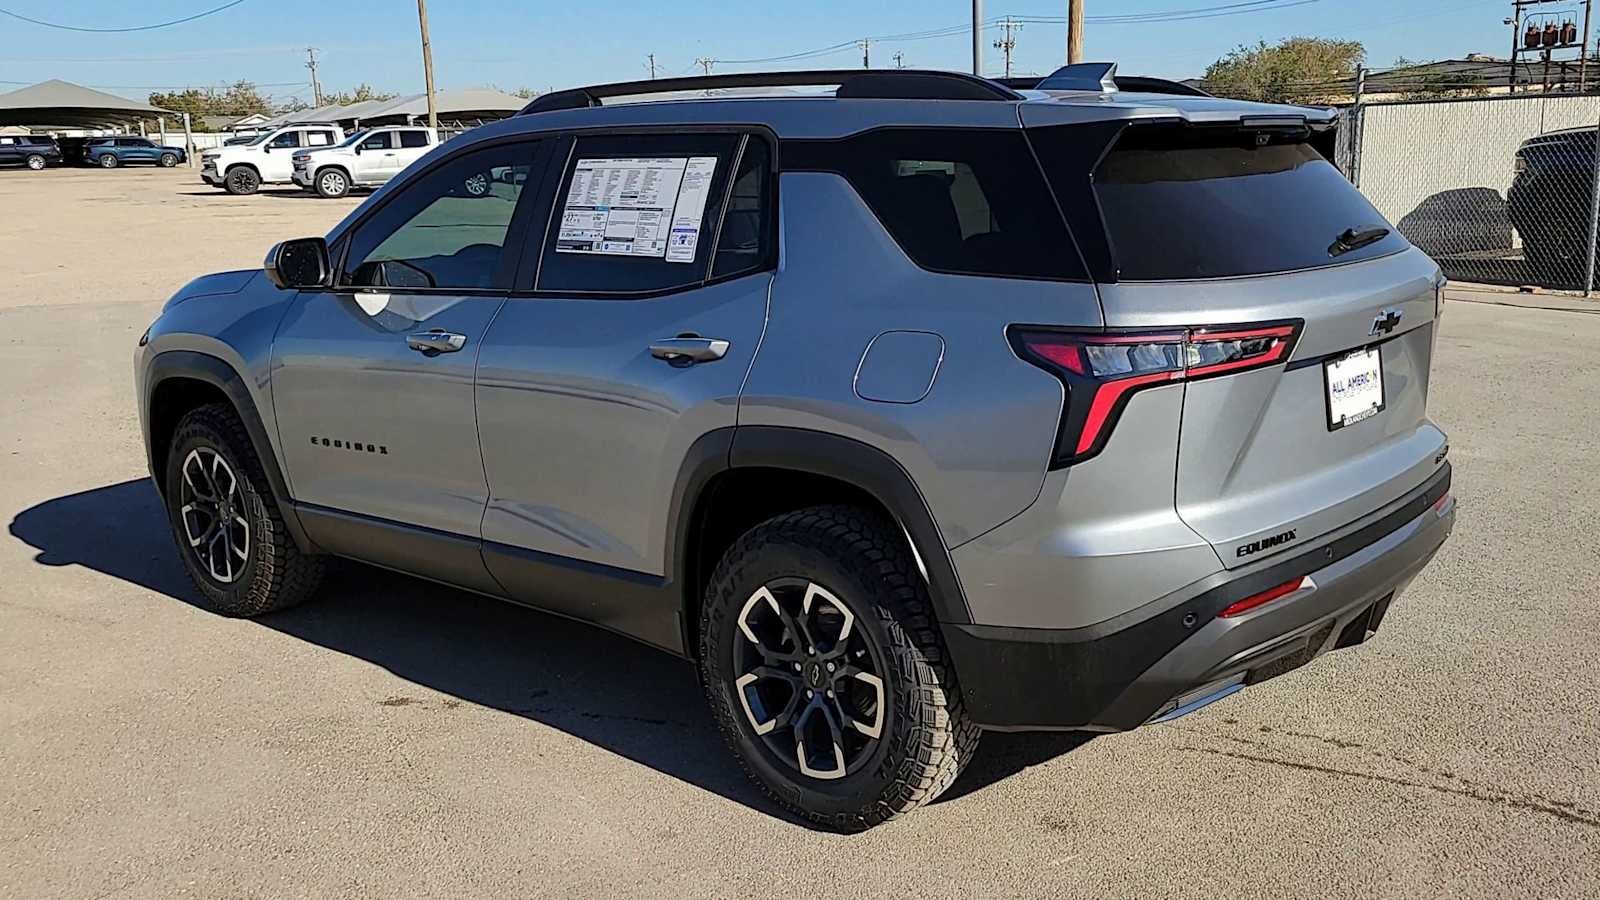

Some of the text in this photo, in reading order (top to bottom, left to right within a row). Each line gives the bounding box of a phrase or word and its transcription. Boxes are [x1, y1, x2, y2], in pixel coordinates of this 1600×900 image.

[1332, 380, 1345, 394] ALL
[310, 436, 388, 455] EQUINOX
[1236, 528, 1297, 558] EQUINOX
